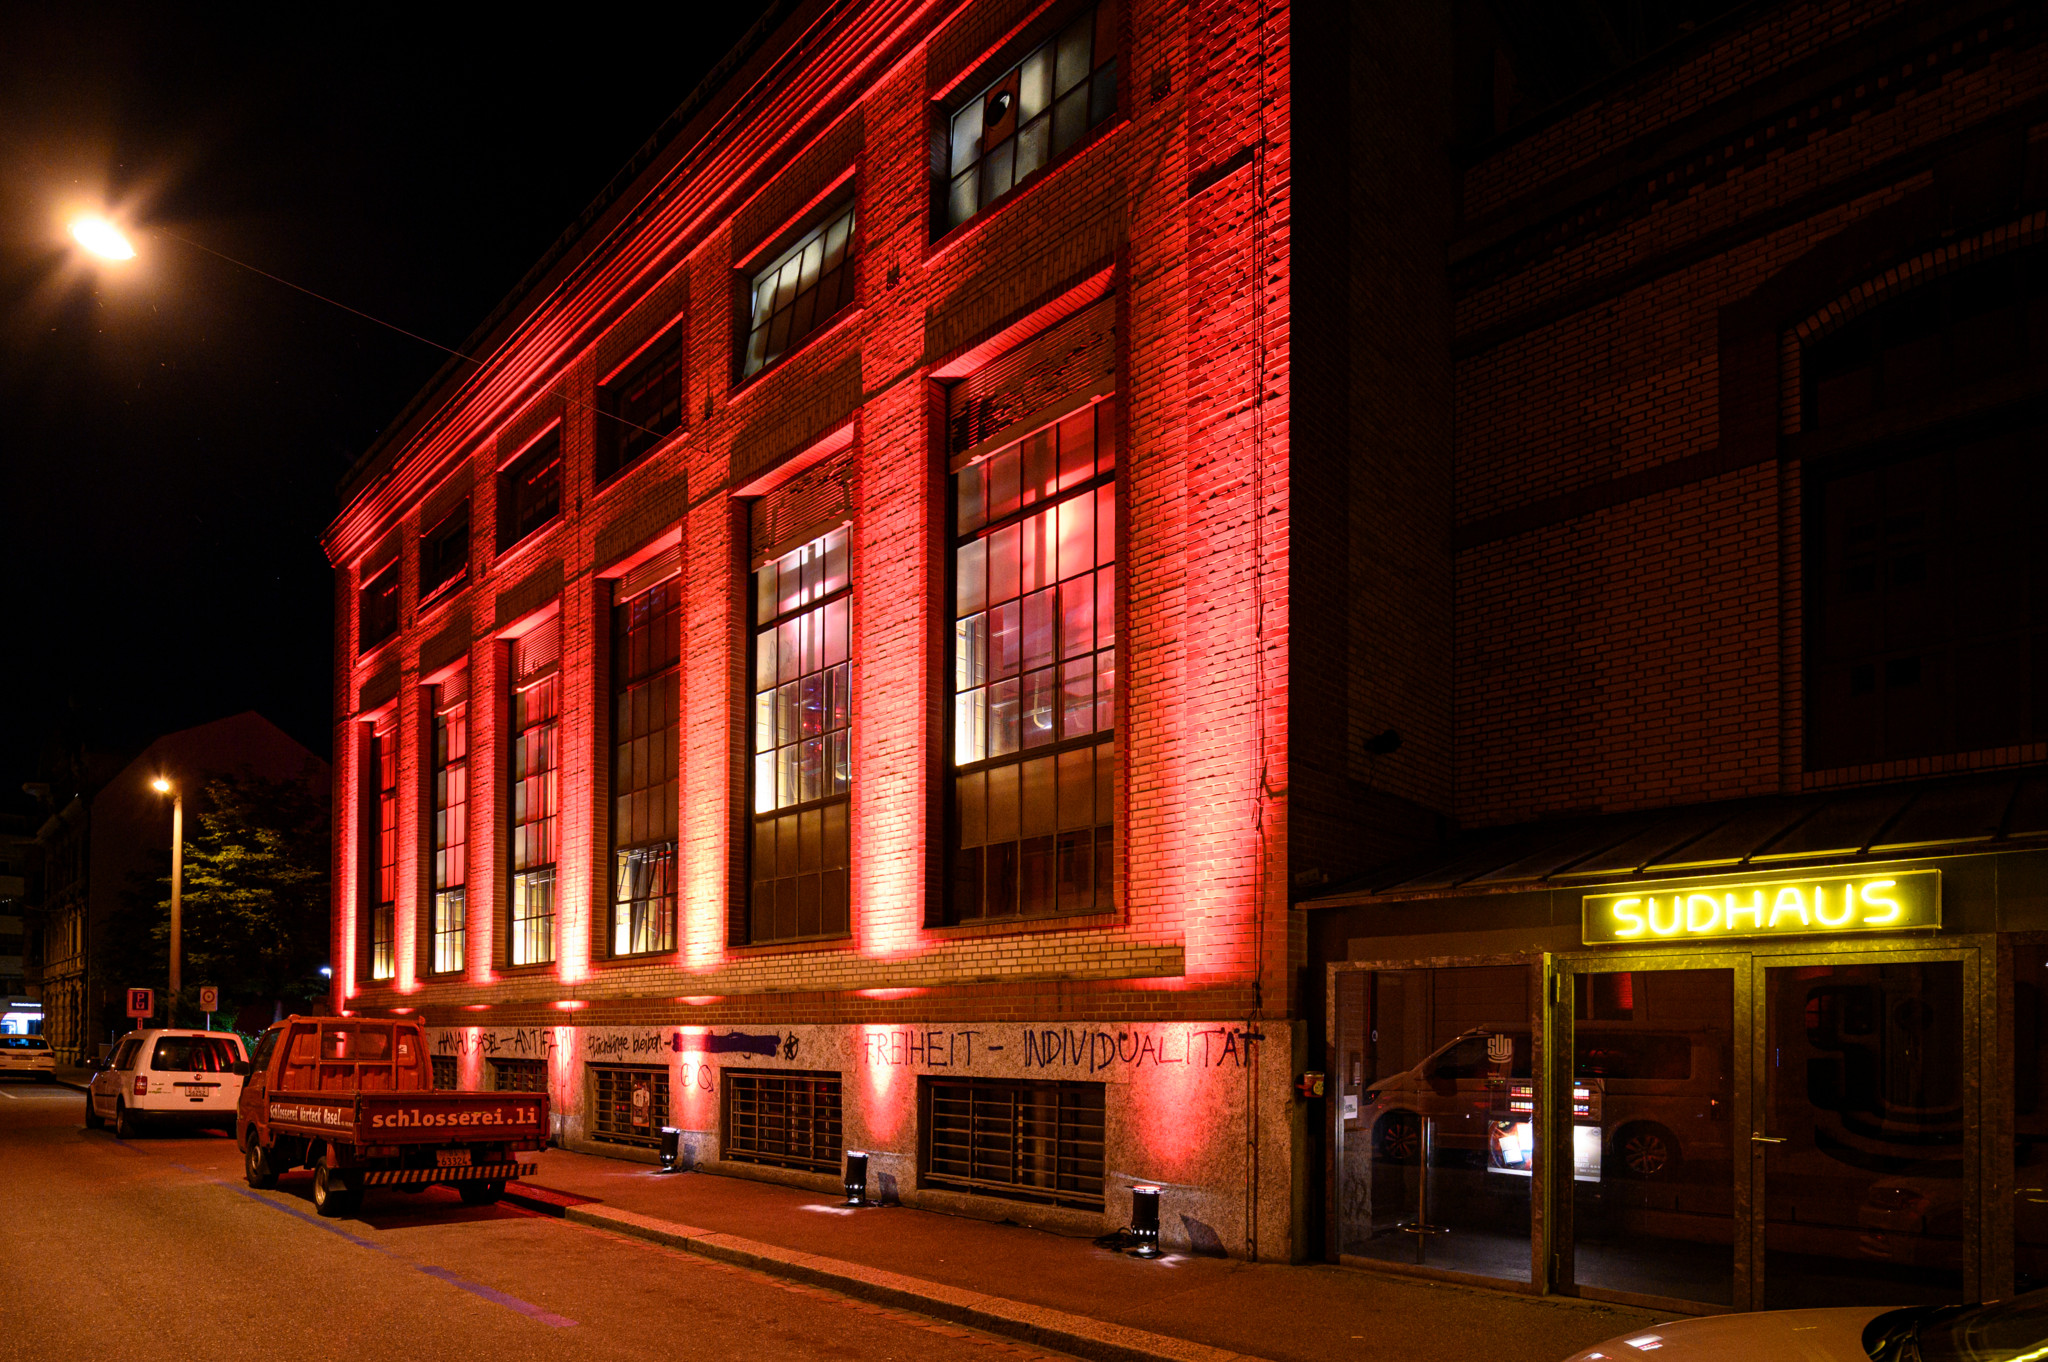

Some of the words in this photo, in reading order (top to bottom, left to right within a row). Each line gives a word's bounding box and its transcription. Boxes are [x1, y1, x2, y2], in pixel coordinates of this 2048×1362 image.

[1611, 879, 1902, 937] SUDHAUS
[438, 1030, 469, 1055] HANAU
[471, 1031, 501, 1055] BASEL
[515, 1028, 560, 1058] ANTIFA
[864, 1030, 980, 1068] FREIHEIT
[269, 1104, 298, 1121] Schlosserei
[299, 1106, 321, 1124] Warteck
[323, 1108, 342, 1125] Basel
[371, 1107, 538, 1128] schlosserei.li
[441, 1156, 468, 1166] 63324
